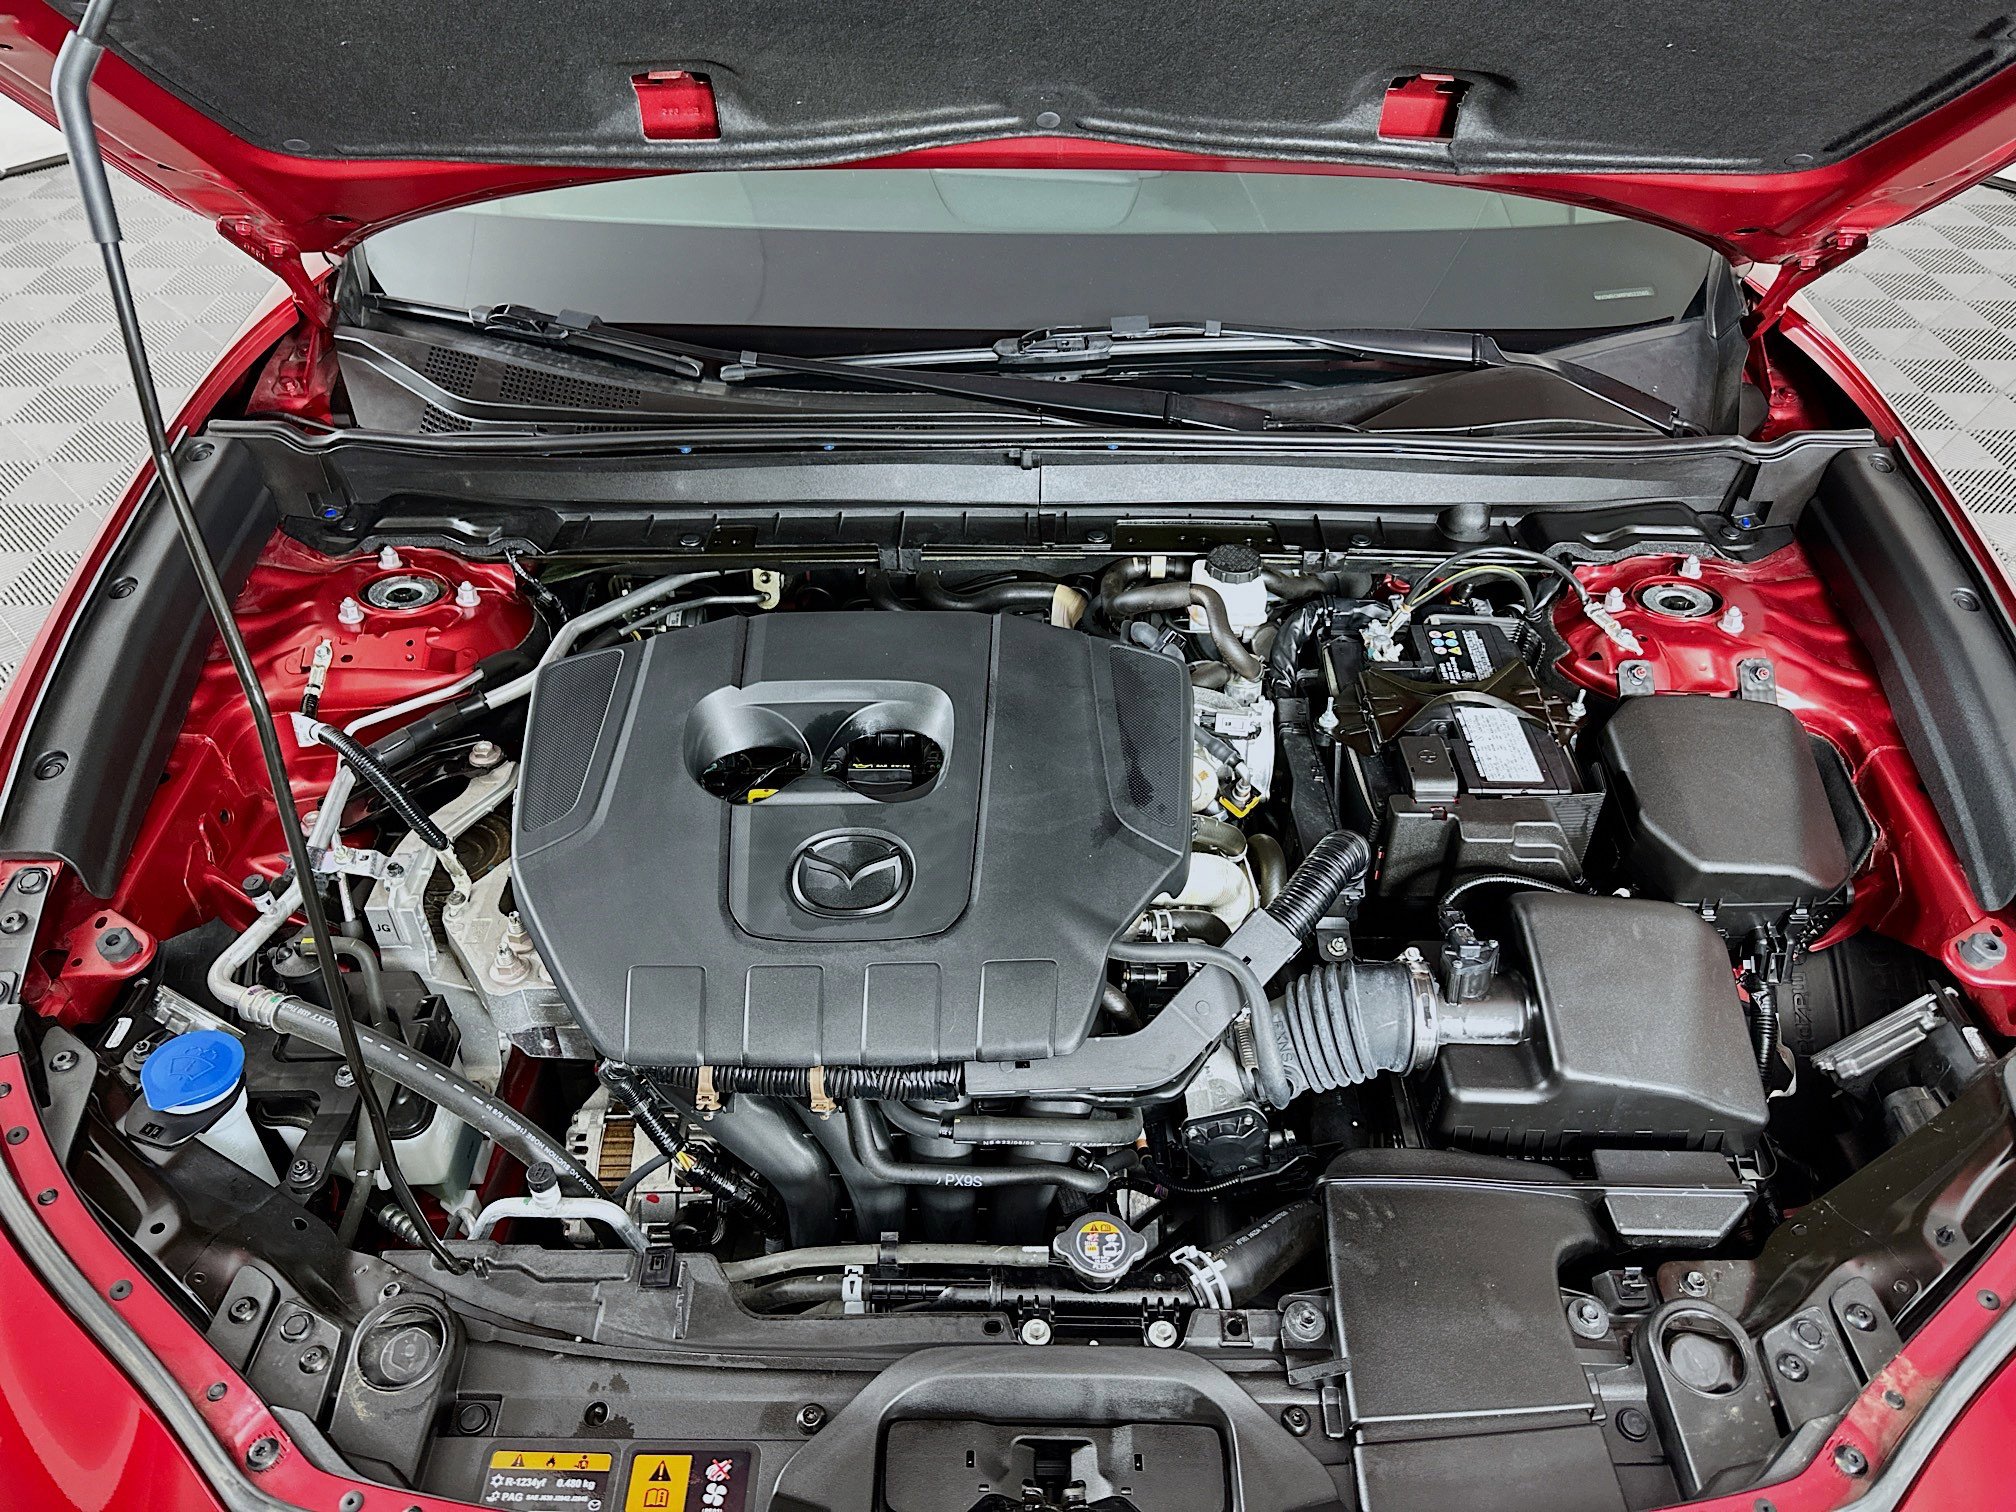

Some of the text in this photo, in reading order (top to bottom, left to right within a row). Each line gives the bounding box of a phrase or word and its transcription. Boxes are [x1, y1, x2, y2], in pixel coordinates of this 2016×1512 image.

[375, 924, 391, 932] JG
[526, 1132, 545, 1149] HOSE
[543, 1146, 572, 1171] SUCTION
[569, 1168, 581, 1179] A/C
[945, 1173, 982, 1187] PX9S
[505, 1477, 547, 1489] R-1234yf
[582, 1479, 596, 1490] kg
[501, 1492, 523, 1501] PAG
